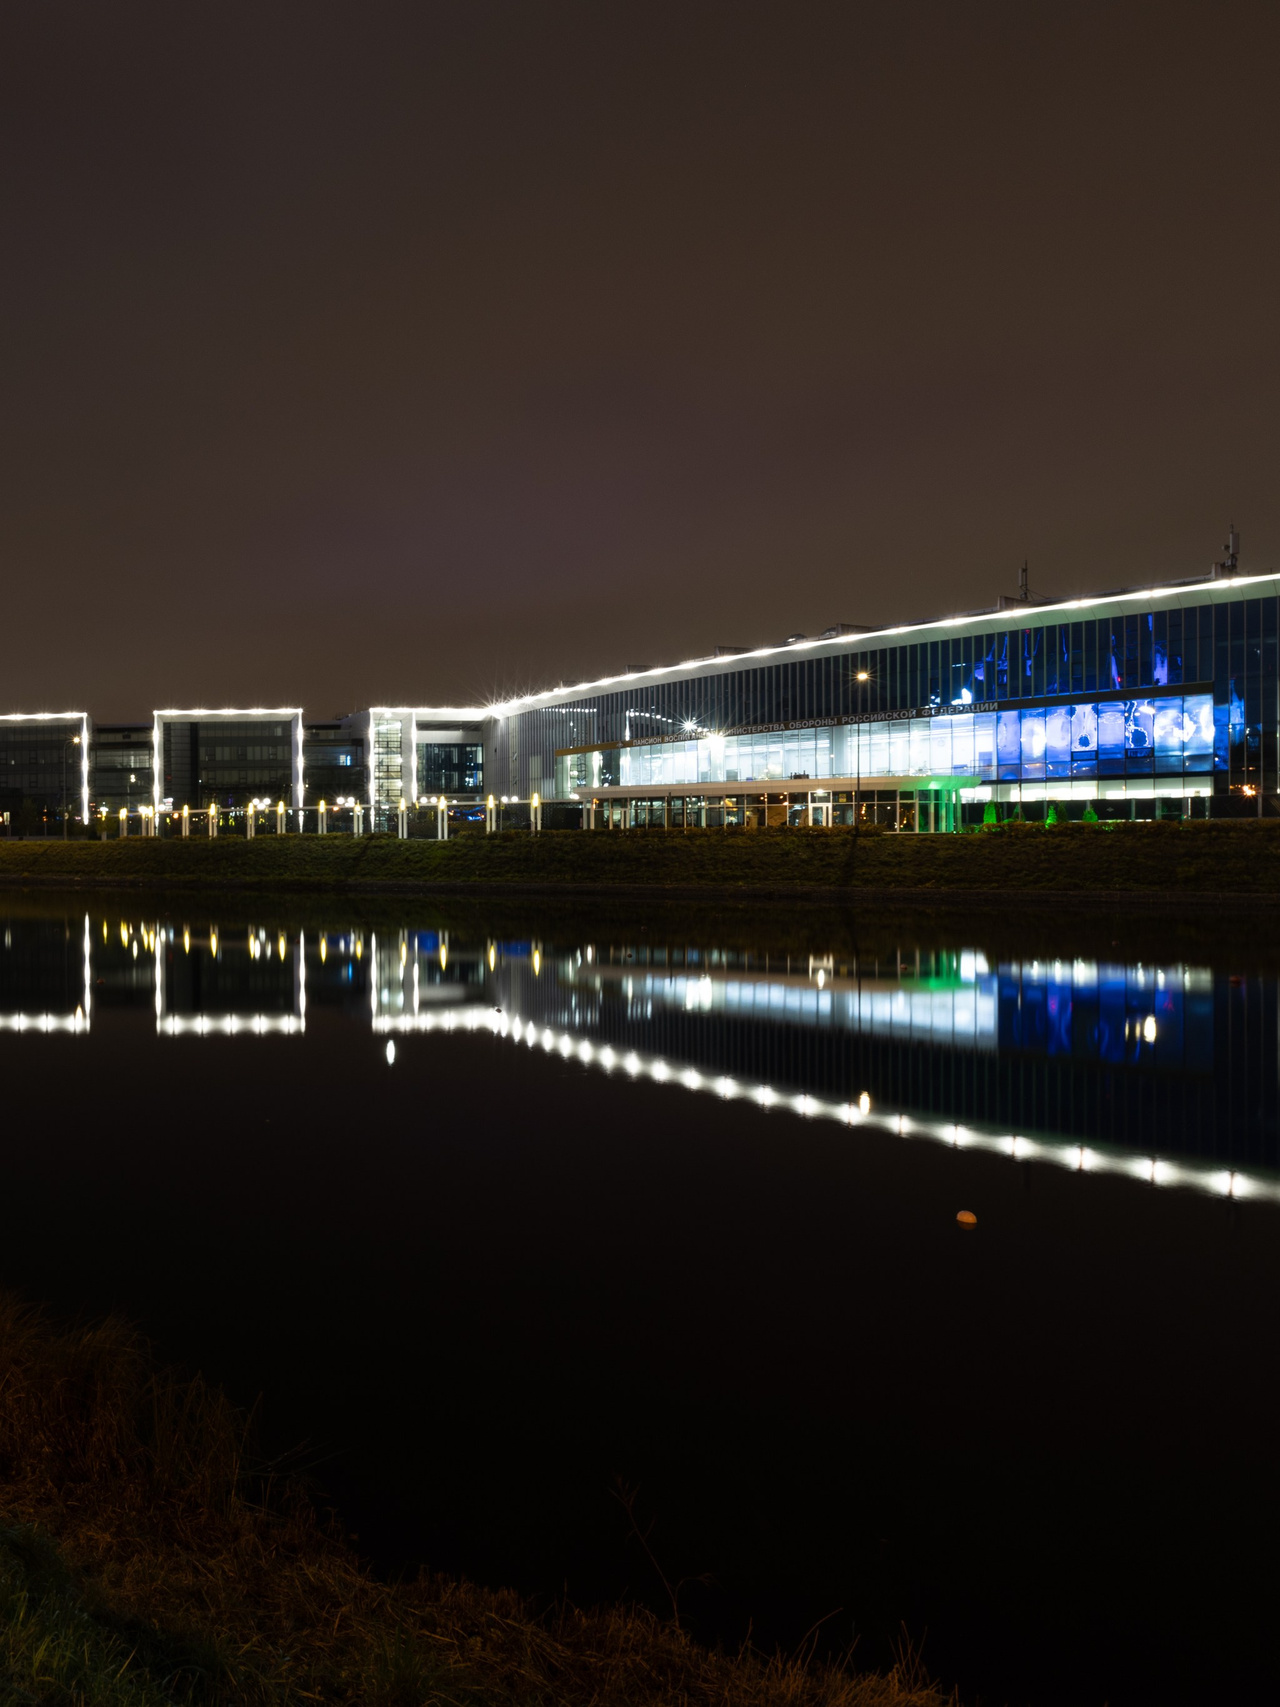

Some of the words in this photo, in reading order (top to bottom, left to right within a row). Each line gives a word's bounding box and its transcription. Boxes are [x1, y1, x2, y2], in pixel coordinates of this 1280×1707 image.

[633, 737, 662, 746] ПАНСИОН
[664, 730, 716, 742] ВОСПИТАН
[789, 717, 838, 729] ОБОРОНЫ
[841, 709, 917, 724] РОССИЙСКОЙ
[921, 702, 999, 717] ФЕДЕРАЦИИ
